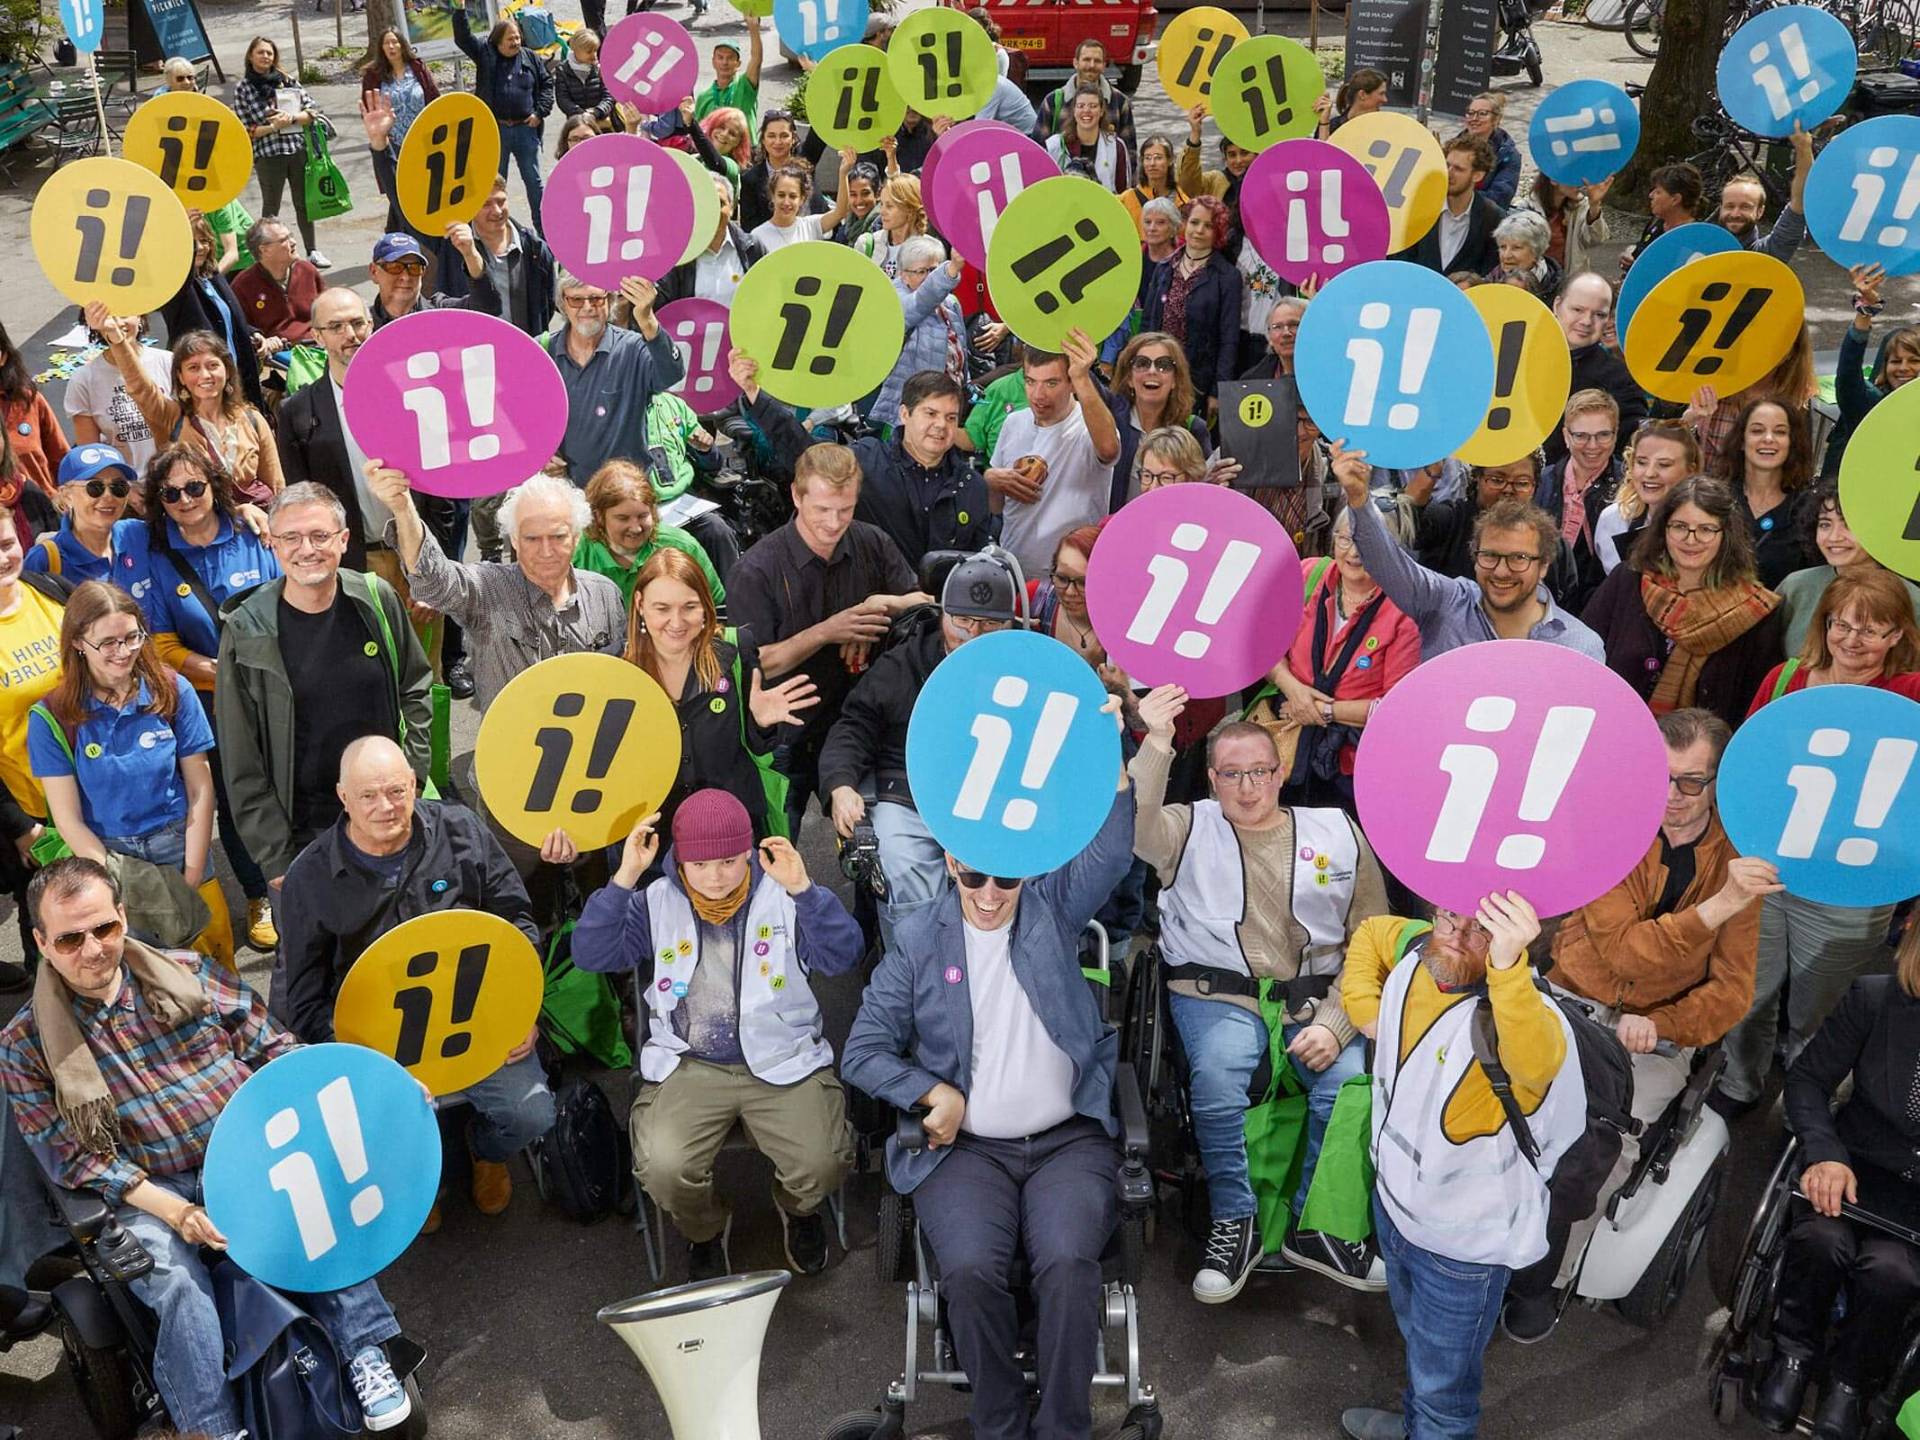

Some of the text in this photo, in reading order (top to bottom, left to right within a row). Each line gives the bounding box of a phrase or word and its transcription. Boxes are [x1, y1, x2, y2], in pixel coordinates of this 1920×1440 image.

[918, 31, 962, 100] i!
[1241, 55, 1293, 137] i!
[1750, 23, 1819, 121] i!
[159, 116, 219, 191] i!
[426, 117, 474, 215] i!
[1839, 147, 1920, 247] i!
[74, 189, 151, 287] i!
[584, 165, 652, 264] i!
[772, 276, 863, 375] i!
[1343, 302, 1442, 431] i!
[1656, 282, 1773, 375] i!
[403, 343, 498, 470] i!
[1249, 401, 1262, 420] i!
[1127, 523, 1260, 658] i!
[524, 693, 636, 813] i!
[952, 676, 1079, 831] i!
[1425, 696, 1596, 869] i!
[1777, 728, 1918, 866] i!
[394, 944, 490, 1068] i!
[264, 1076, 384, 1262] i!
